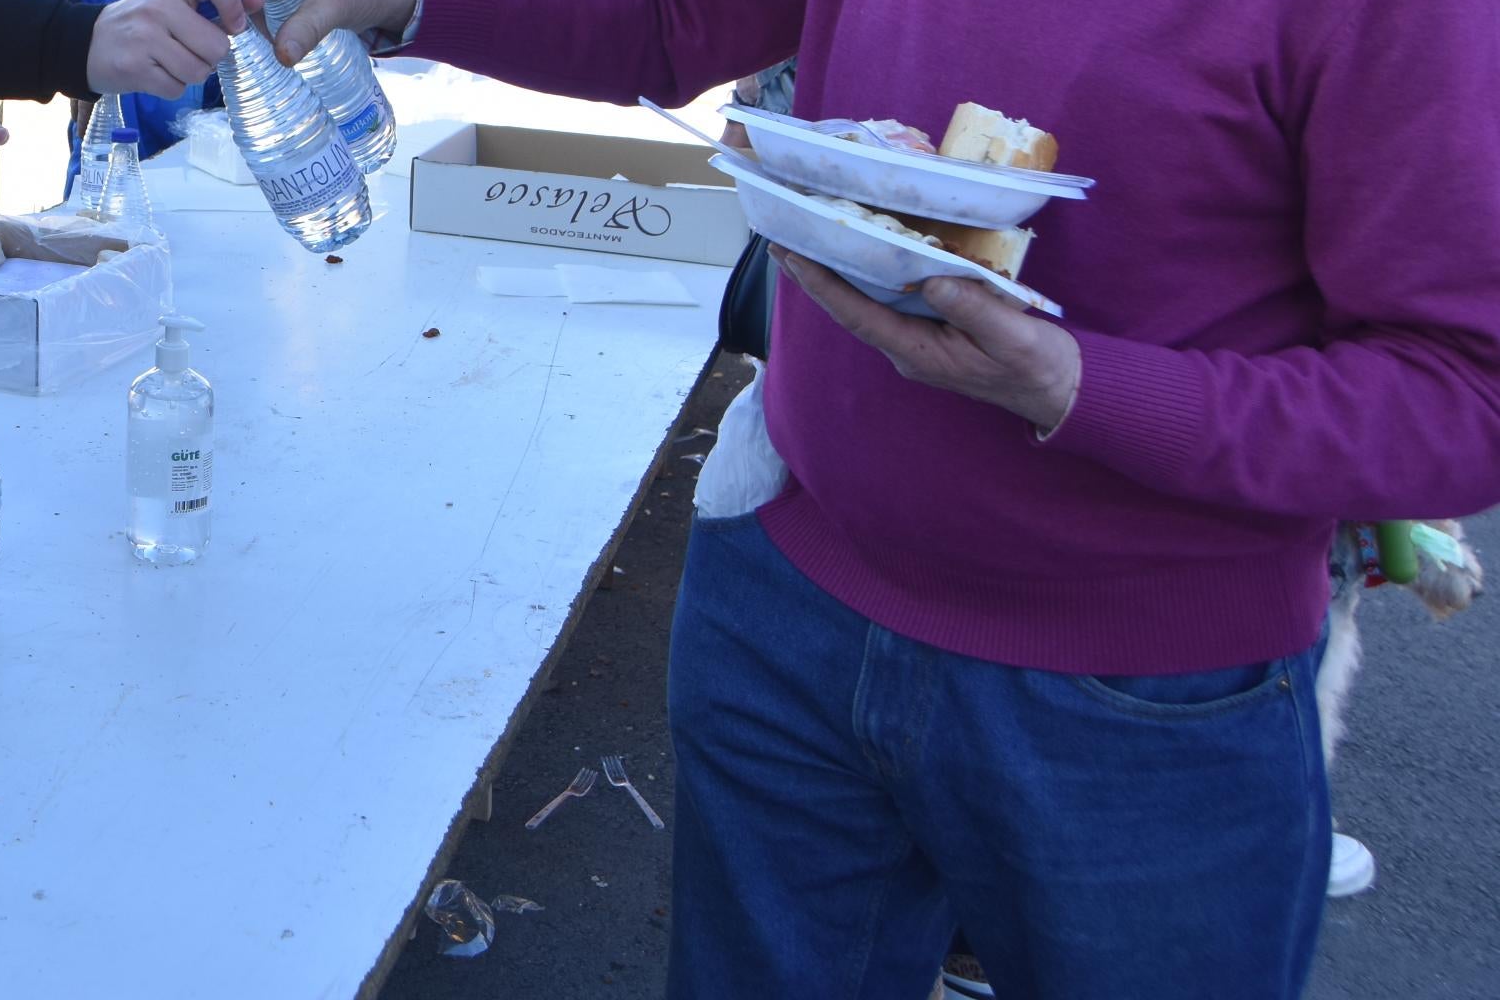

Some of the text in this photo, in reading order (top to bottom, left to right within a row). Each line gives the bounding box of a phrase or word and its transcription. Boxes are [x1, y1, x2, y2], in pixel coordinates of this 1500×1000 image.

[260, 138, 350, 202] SANTOLÍN
[484, 181, 672, 237] Velasco
[530, 226, 622, 243] MANTECADOS
